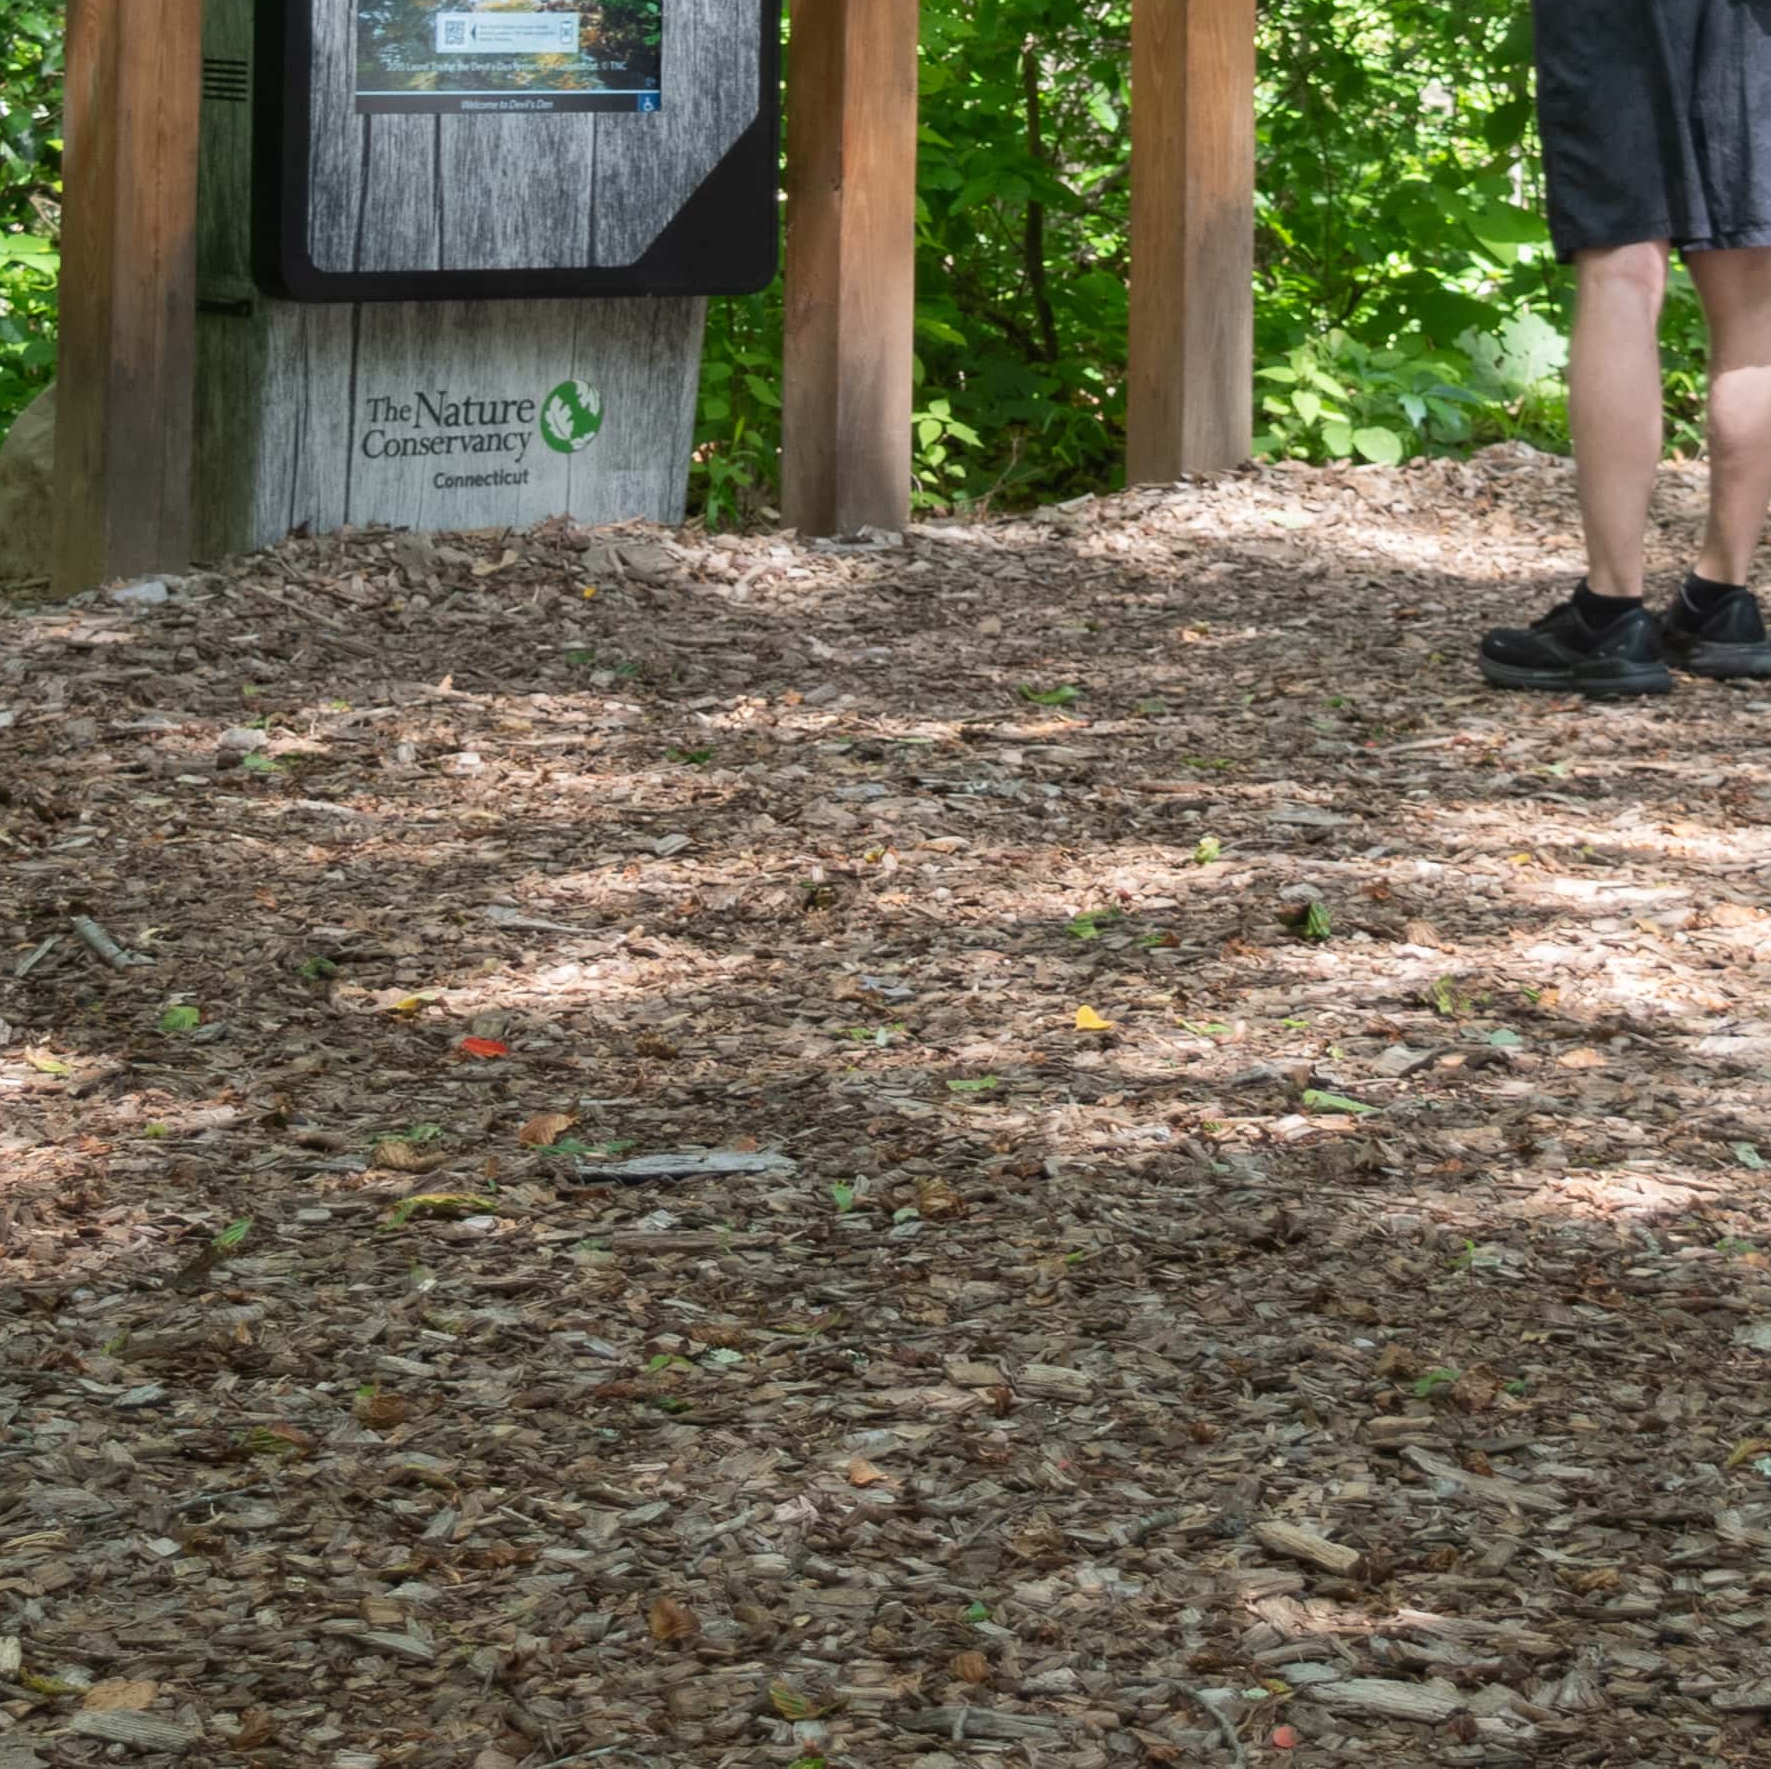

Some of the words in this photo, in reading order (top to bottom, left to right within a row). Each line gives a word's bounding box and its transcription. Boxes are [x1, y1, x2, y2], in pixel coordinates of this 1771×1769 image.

[461, 99, 499, 109] Welcome
[500, 100, 508, 109] to
[509, 99, 535, 109] Devil's
[536, 100, 554, 109] Den
[366, 396, 412, 423] The
[413, 390, 536, 429] Nature
[362, 429, 533, 463] Conservancy
[433, 468, 530, 490] Connecticut
